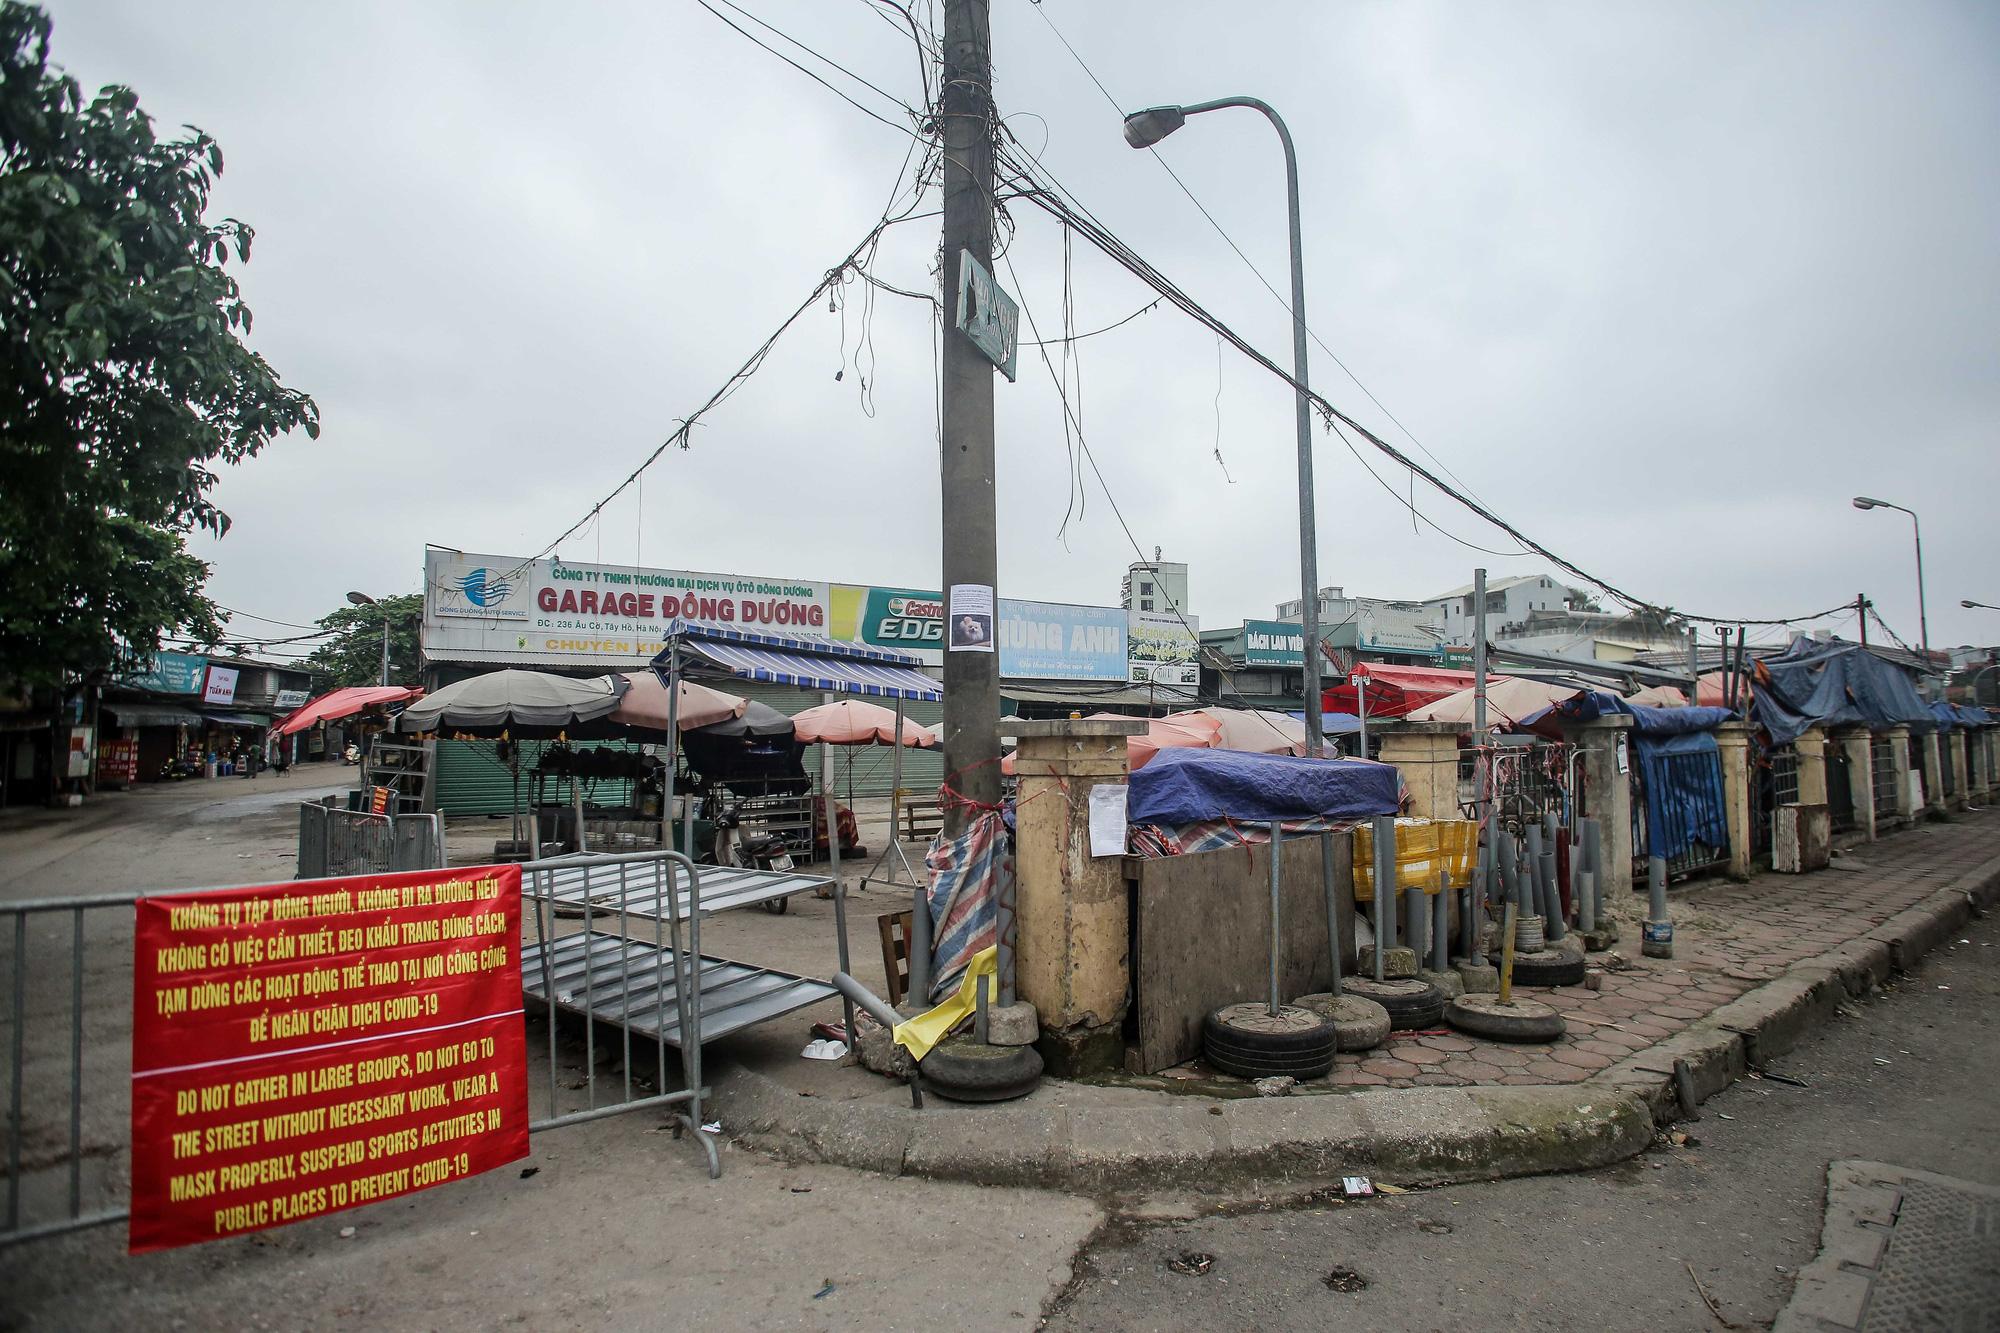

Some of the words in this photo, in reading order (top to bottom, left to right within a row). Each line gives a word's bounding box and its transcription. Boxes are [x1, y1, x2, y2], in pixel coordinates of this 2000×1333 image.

[552, 567, 583, 580] CÔNG
[586, 571, 600, 583] TY
[603, 572, 631, 585] TNHH
[633, 573, 675, 589] THƯƠNG
[677, 577, 695, 591] MẠI
[697, 579, 720, 593] DỊCH
[721, 580, 734, 594] VỤ
[736, 582, 755, 595] ÔTÔ
[756, 583, 782, 596] ĐÔNG
[783, 585, 813, 598] DƯƠNG
[538, 587, 655, 617] GARAGE
[662, 591, 735, 622] ĐÔNG
[742, 598, 824, 627] DƯƠNG
[557, 620, 572, 629] 236
[575, 619, 586, 629] Âu
[605, 622, 618, 632] Tây
[637, 624, 646, 632] Hà
[649, 625, 661, 634] Nội
[905, 600, 943, 619] Castro
[545, 637, 629, 653] CHUYÊN
[637, 642, 667, 653] KIN
[876, 618, 943, 640] EDG
[999, 613, 1063, 652] HÙNG
[1070, 625, 1120, 654] ANH
[1247, 630, 1270, 650] BÁCH
[1271, 635, 1287, 651] LAN
[1287, 633, 1304, 652] VIÊ
[222, 688, 233, 697] ANH
[171, 902, 220, 930] KHÔNG
[223, 903, 240, 929] TỤ
[244, 897, 270, 928] TẬP
[273, 894, 309, 921] ĐÔNG
[312, 888, 355, 917] NGƯỜI,
[358, 886, 399, 912] KHÔNG
[402, 887, 414, 907] ĐI
[417, 885, 432, 906] RA
[435, 878, 474, 904] ĐƯỜNG
[476, 873, 499, 900] NẾU
[158, 943, 206, 973] KHÔNG
[211, 938, 229, 967] CÓ
[233, 936, 263, 967] VIỆC
[268, 929, 295, 960] CẦN
[299, 925, 335, 956] THIẾT,
[339, 928, 363, 952] ĐEO
[366, 917, 398, 948] KHẨU
[401, 920, 439, 944] TRANG
[442, 916, 474, 939] ĐÚNG
[476, 912, 506, 937] CÁCH,
[157, 988, 187, 1018] TẠM
[191, 981, 230, 1010] DỪNG
[234, 975, 261, 1004] CÁC
[266, 974, 300, 1002] HOẠT
[303, 967, 338, 998] ĐỘNG
[342, 956, 365, 989] THỂ
[368, 961, 399, 986] THAO
[402, 959, 420, 985] TẠI
[424, 954, 444, 978] NƠI
[447, 949, 478, 975] CÔNG
[481, 945, 506, 970] CỘNG
[250, 1008, 268, 1042] ĐỂ
[272, 1009, 309, 1039] NGĂN
[313, 1004, 348, 1035] CHẶN
[352, 1001, 381, 1030] DỊCH
[384, 993, 438, 1021] COVID-19
[177, 1089, 197, 1115] DO
[202, 1084, 230, 1111] NOT
[235, 1075, 288, 1106] GATHER
[292, 1072, 307, 1096] IN
[311, 1064, 353, 1093] LARGE
[358, 1054, 413, 1084] GROUPS,
[417, 1050, 433, 1073] DO
[437, 1044, 459, 1069] NOT
[463, 1041, 477, 1063] GO
[480, 1037, 494, 1058] TO
[173, 1130, 201, 1158] THE
[206, 1120, 259, 1152] STREET
[263, 1108, 326, 1142] WITHOUT
[330, 1093, 405, 1129] NECESSARY
[409, 1084, 449, 1112] WORK,
[453, 1074, 487, 1101] WEAR
[490, 1072, 498, 1093] A
[171, 1170, 215, 1201] MASK
[221, 1155, 295, 1191] PROPERLY,
[300, 1140, 364, 1174] SUSPEND
[369, 1128, 418, 1159] SPORTS
[422, 1111, 485, 1147] ACTIVITIES
[488, 1108, 500, 1130] IN
[216, 1201, 268, 1232] PUBLIC
[273, 1188, 326, 1221] PLACES
[330, 1183, 347, 1207] TO
[351, 1168, 409, 1202] PREVENT
[413, 1153, 468, 1187] COVID-19
